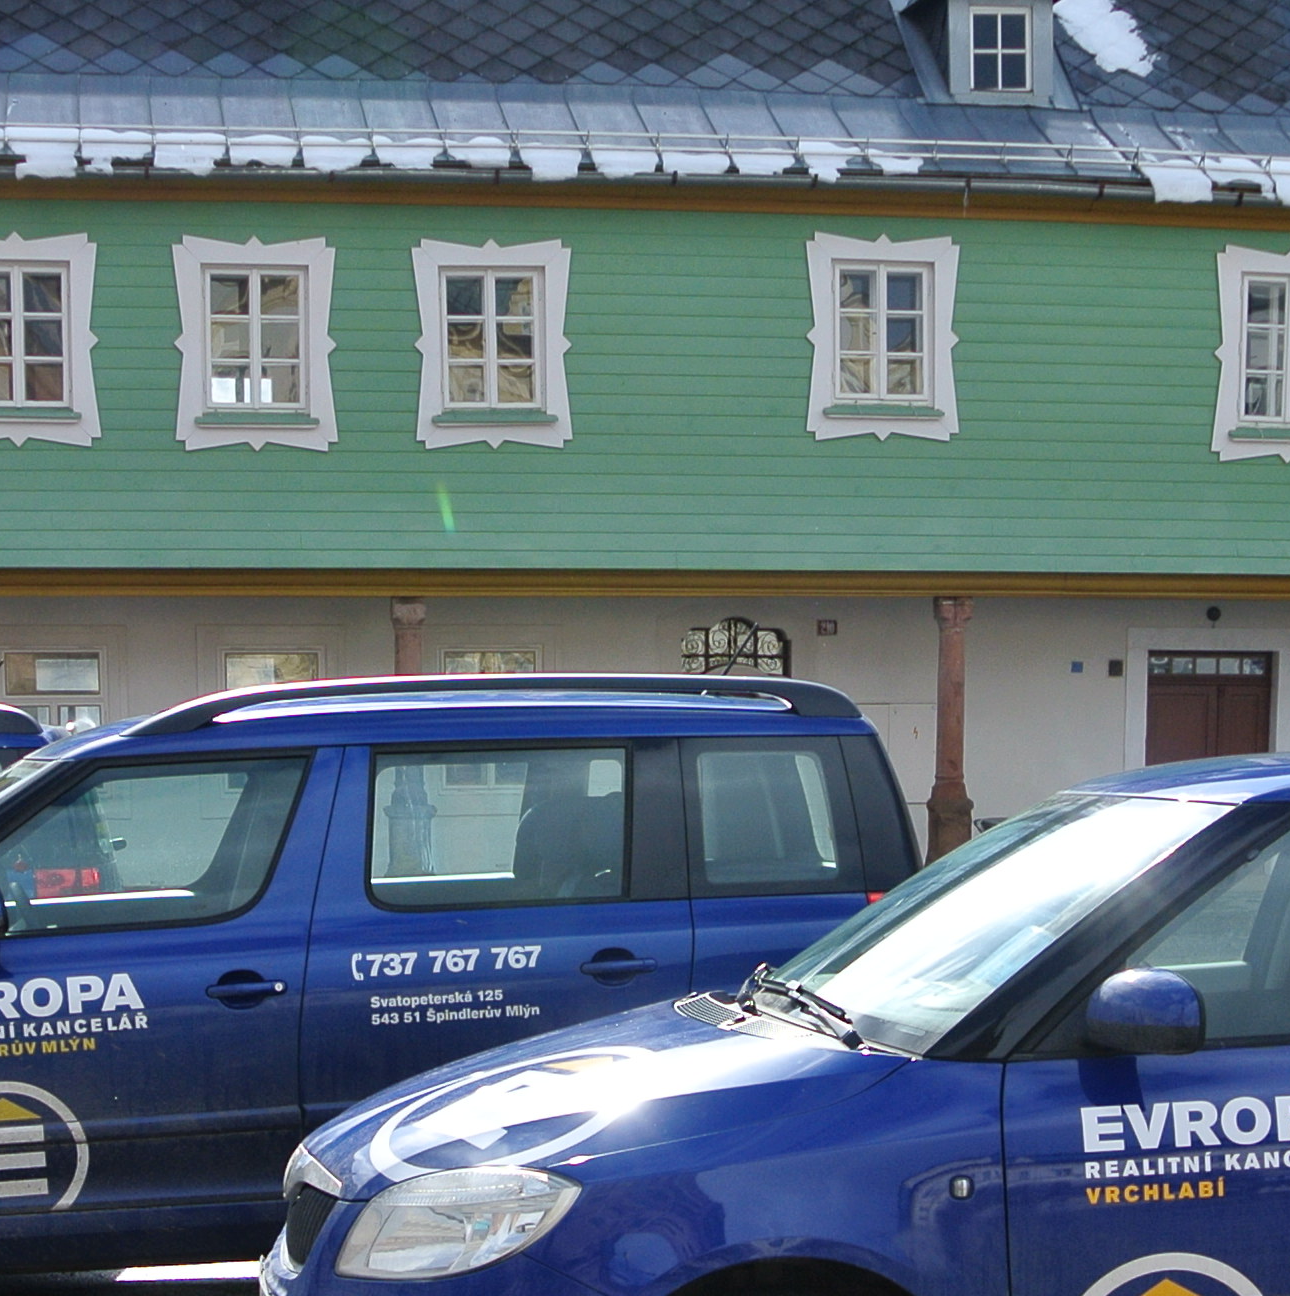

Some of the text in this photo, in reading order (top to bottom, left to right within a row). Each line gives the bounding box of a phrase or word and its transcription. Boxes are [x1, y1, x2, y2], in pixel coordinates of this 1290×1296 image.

[366, 945, 541, 977] 737 767 767
[370, 989, 503, 1008] Svatopeterská 125
[22, 1012, 148, 1037] KANCELÁŘ
[371, 1003, 540, 1025] 543 51 Špindlerův Mlýn
[42, 1036, 96, 1054] MLÝN
[1085, 1151, 1211, 1179] REALITNÍ
[1085, 1176, 1225, 1204] VRCHLABÍ
